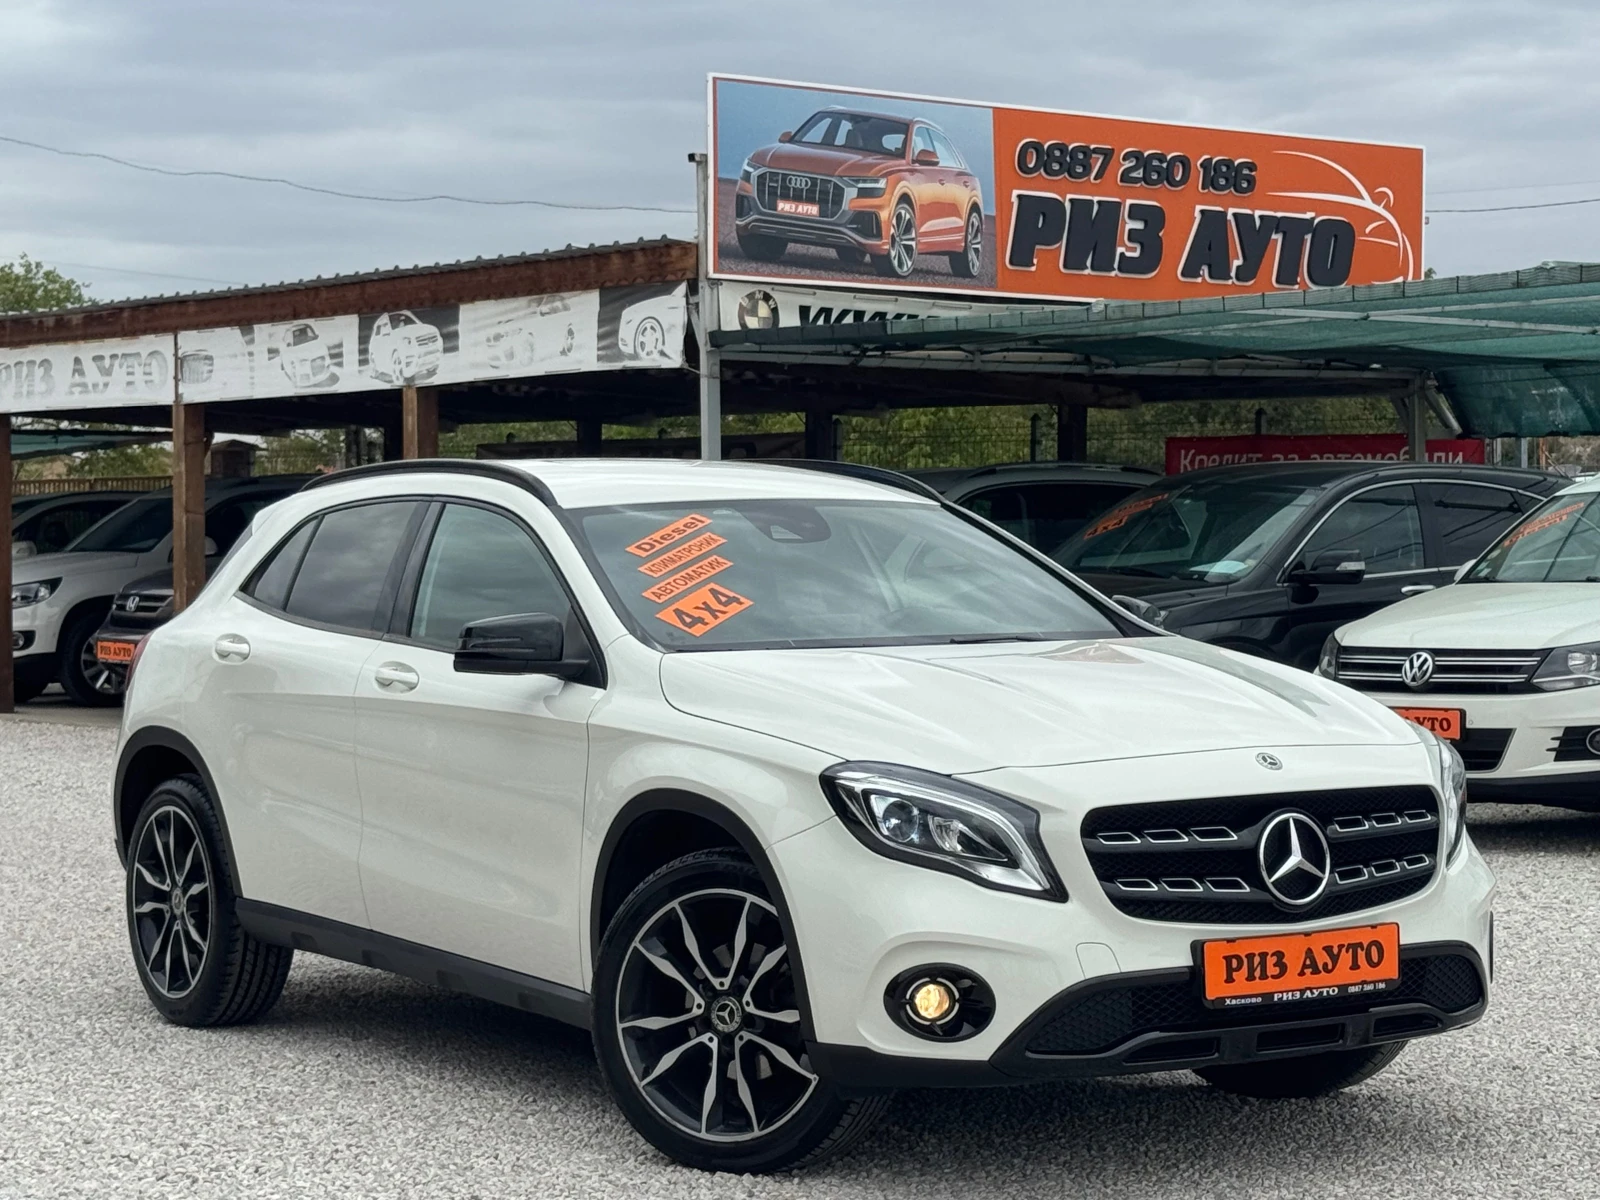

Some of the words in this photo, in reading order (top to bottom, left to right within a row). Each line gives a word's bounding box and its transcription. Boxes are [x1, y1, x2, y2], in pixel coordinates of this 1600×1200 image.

[1016, 139, 1114, 183] 0887
[1119, 149, 1191, 189] 260
[1198, 155, 1258, 196] 186
[778, 202, 797, 213] РИЗ
[797, 204, 818, 216] АУТО
[1005, 189, 1166, 277] РИЗ
[1177, 205, 1356, 289] АУТО
[65, 349, 169, 396] АУТО
[635, 516, 706, 553] Diesel
[644, 533, 721, 575] КЛИМАТРОНИК
[650, 557, 727, 601] АВТОМАТИК
[1222, 950, 1288, 984] РИЗ
[1297, 940, 1384, 977] АУТО
[1224, 996, 1262, 1006] Хасково
[1273, 991, 1301, 1002] РИЗ
[1303, 987, 1338, 999] АУТО
